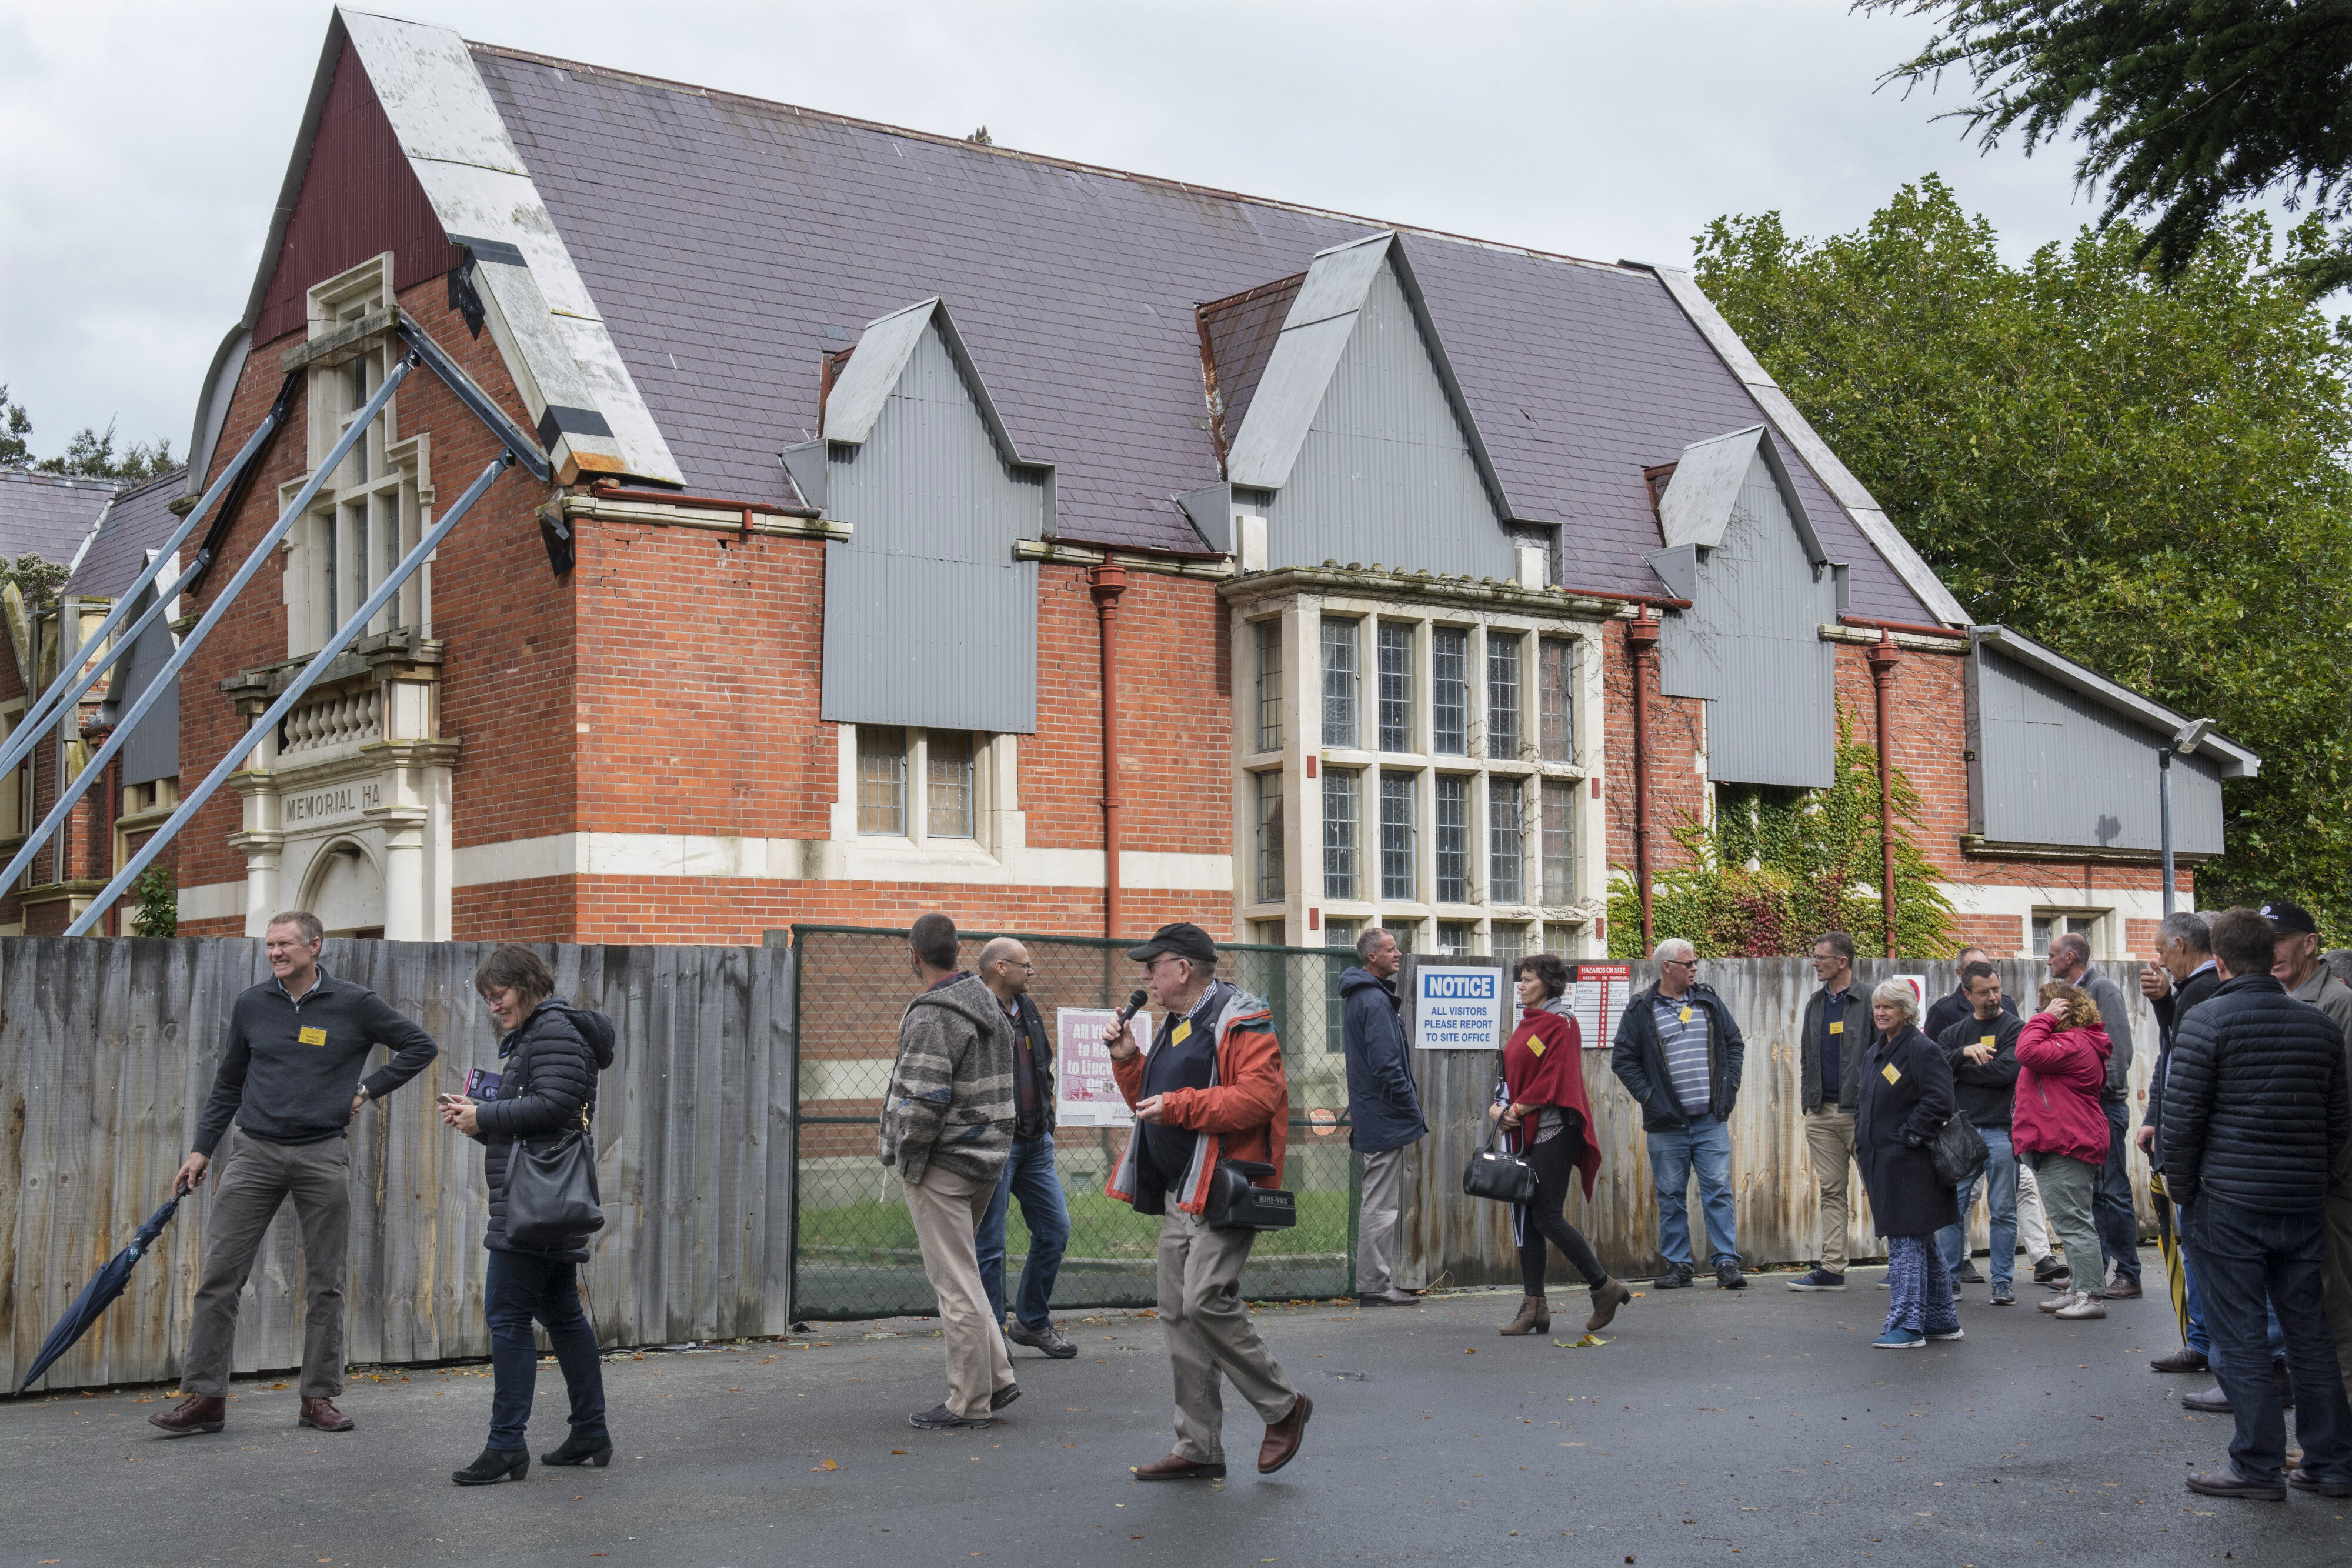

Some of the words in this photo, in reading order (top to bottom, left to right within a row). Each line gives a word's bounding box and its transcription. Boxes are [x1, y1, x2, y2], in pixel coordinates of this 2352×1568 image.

[287, 789, 355, 822] MEMORIAL
[362, 784, 380, 809] HA
[1430, 976, 1491, 996] NOTICE
[1431, 1007, 1447, 1015] ALL
[1449, 1007, 1487, 1016] VISITORS
[1073, 1023, 1089, 1039] All
[1424, 1020, 1457, 1028] PLEASE
[1460, 1020, 1493, 1029] REPORT
[1426, 1033, 1438, 1042] TO
[1440, 1033, 1459, 1042] SITE
[1462, 1033, 1490, 1042] OFFICE
[1078, 1043, 1090, 1057] to
[1067, 1060, 1079, 1075] to
[1259, 1196, 1288, 1205] MINI-VOX
